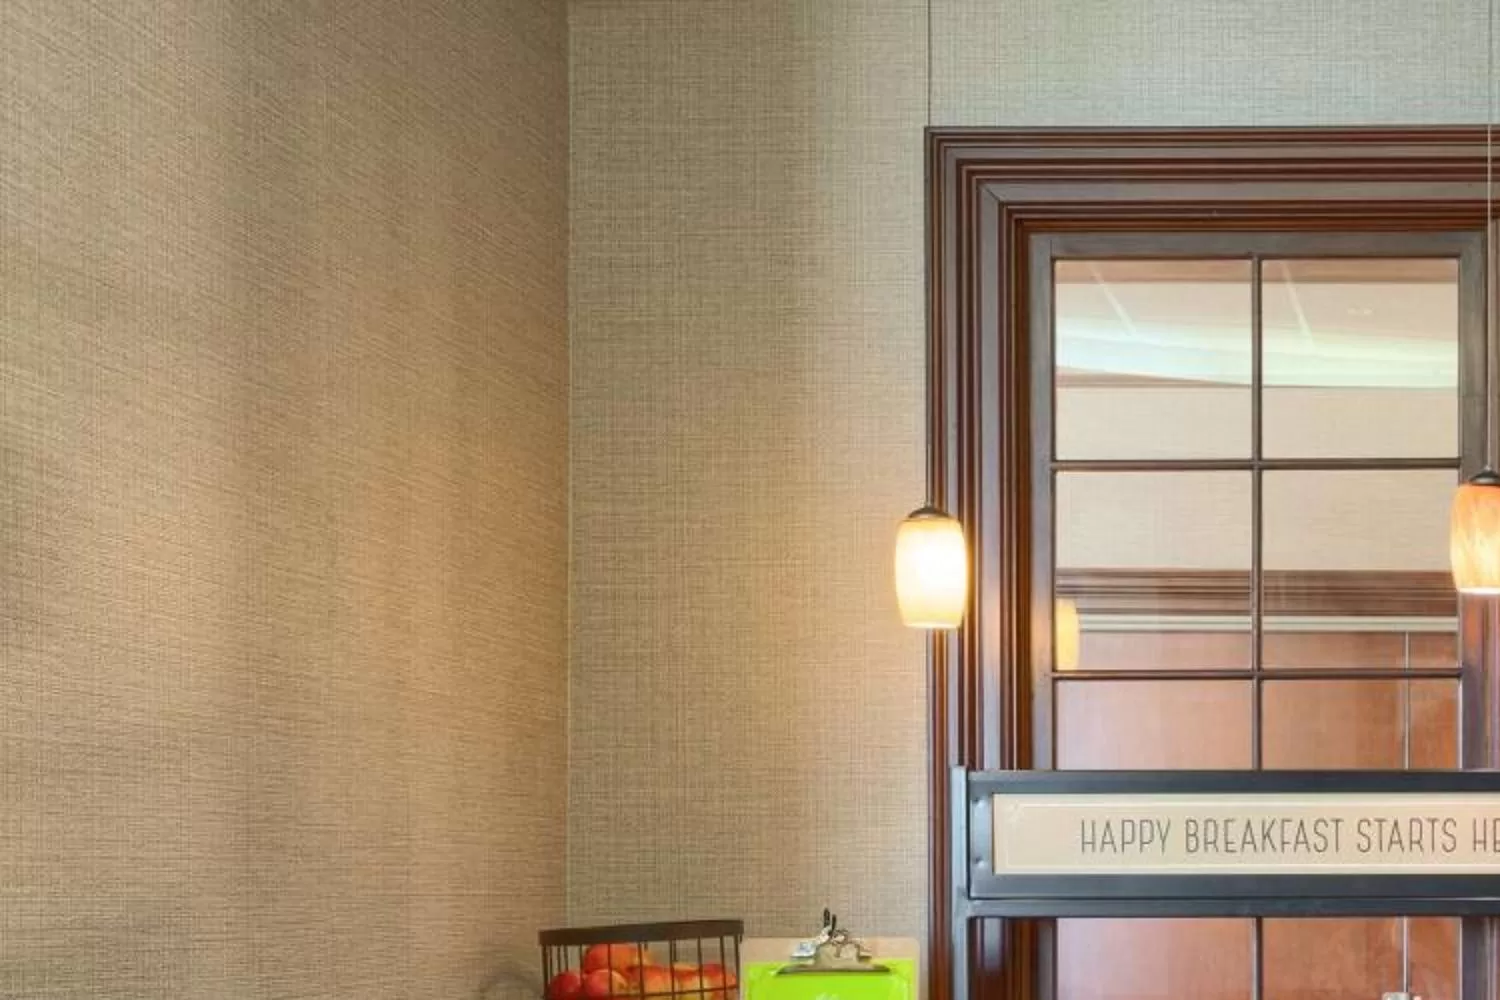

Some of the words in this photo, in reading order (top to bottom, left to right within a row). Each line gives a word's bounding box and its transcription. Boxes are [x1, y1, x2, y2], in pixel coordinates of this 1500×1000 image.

[1081, 818, 1170, 854] HAPPY
[1185, 818, 1343, 854] BREAKFAST
[1356, 818, 1457, 854] STARTS
